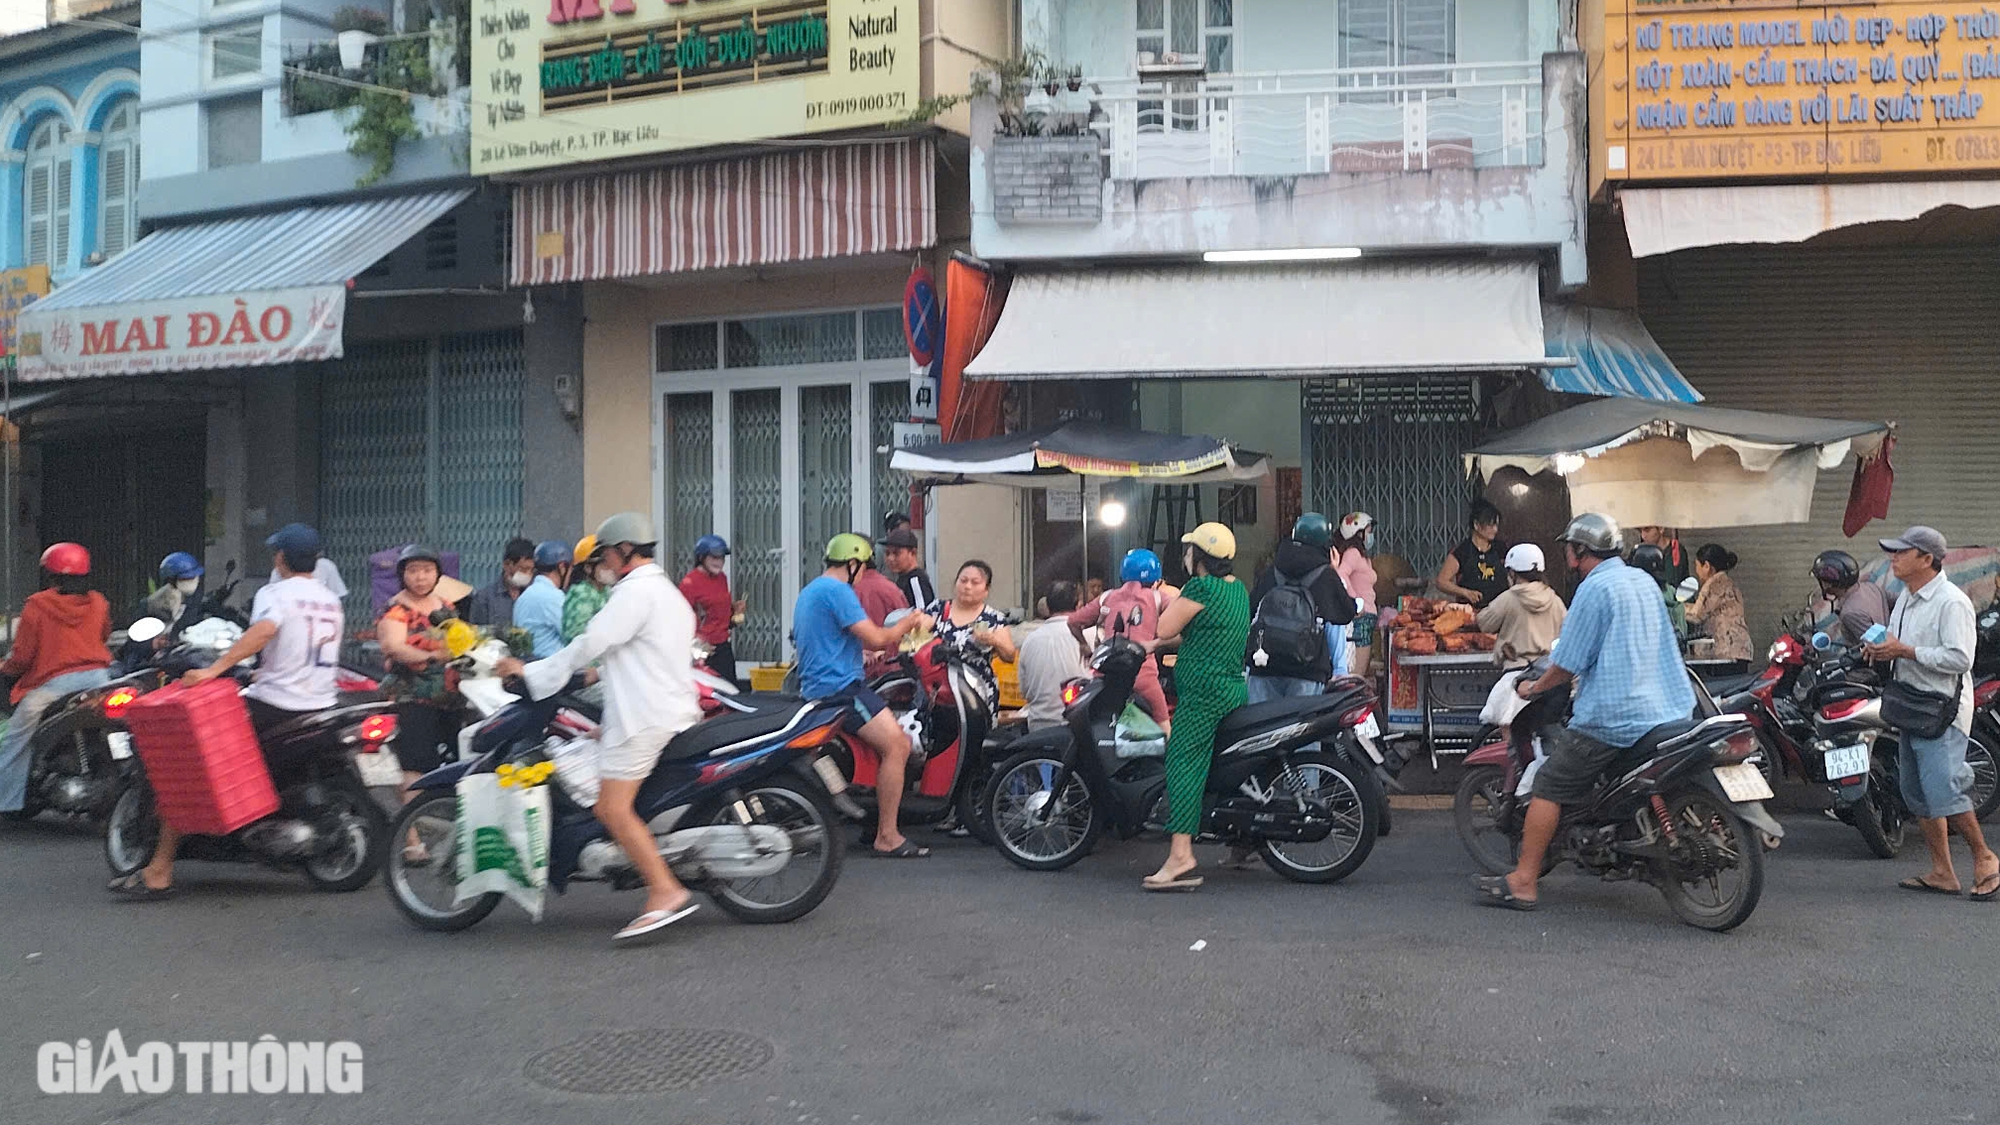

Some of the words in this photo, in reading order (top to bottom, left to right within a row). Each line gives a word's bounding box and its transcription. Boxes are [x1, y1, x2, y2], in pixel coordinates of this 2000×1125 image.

[849, 6, 898, 39] Natural
[1636, 19, 1662, 49] NỮ
[1670, 22, 1734, 49] TRANG
[1740, 20, 1806, 47] MODEL
[1812, 12, 1850, 45] MỚI
[1855, 17, 1894, 49] ĐẸP
[1906, 12, 1946, 48] HỢP
[849, 45, 896, 74] Beauty
[1636, 58, 1673, 95] HỘT
[1794, 57, 1858, 88] THẠCH
[1636, 98, 1687, 133] NHẬN
[1694, 91, 1736, 127] CẦM
[1743, 95, 1792, 124] VÀNG
[1800, 91, 1832, 124] VỚI
[1837, 92, 1868, 123] LÃI
[1875, 84, 1924, 122] SUẤT
[1931, 82, 1984, 122] THẤP
[79, 315, 171, 356] MAI
[187, 298, 292, 348] ĐÀO
